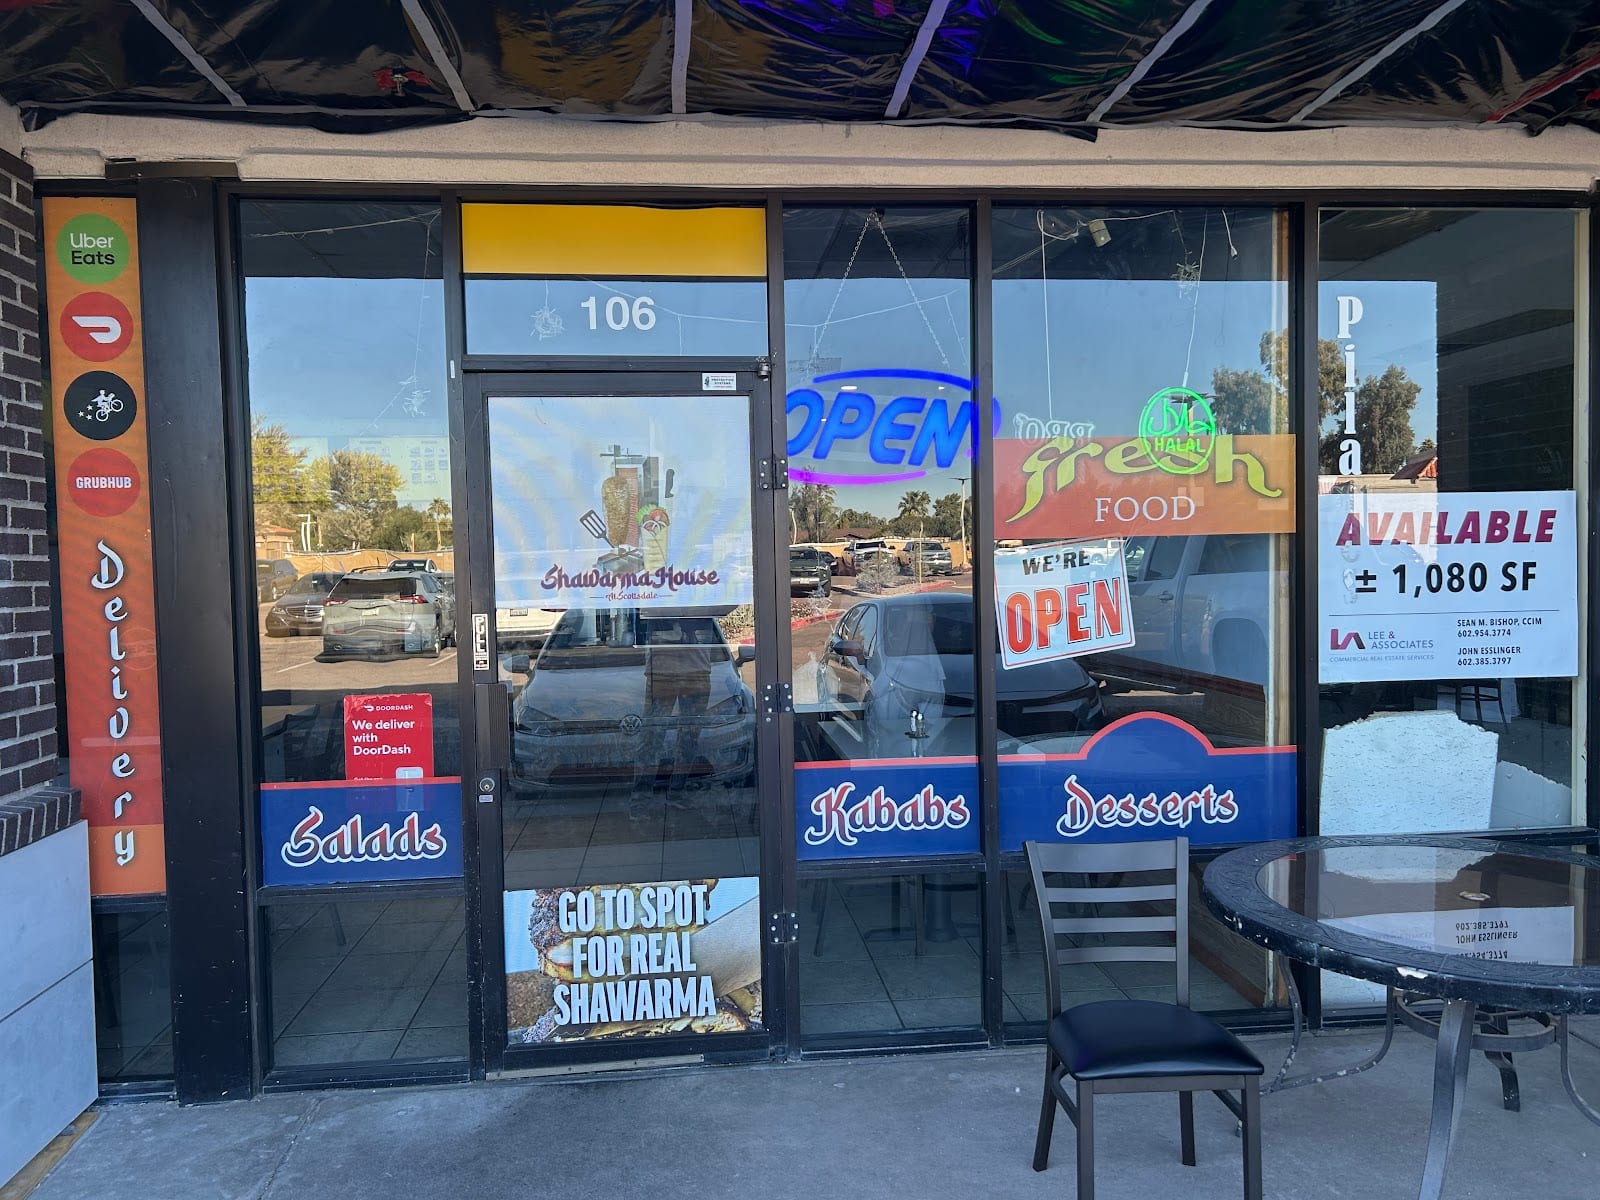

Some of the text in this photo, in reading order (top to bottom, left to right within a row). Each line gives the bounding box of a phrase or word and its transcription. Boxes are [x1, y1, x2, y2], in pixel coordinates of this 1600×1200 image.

[70, 233, 113, 249] Uber
[71, 251, 115, 265] Eats
[580, 296, 656, 331] 106
[786, 388, 971, 468] OPEN
[1154, 437, 1206, 453] HALAL
[76, 476, 132, 489] GRUBHUB
[1005, 433, 1282, 523] fresh
[1095, 495, 1196, 523] FOOD
[1335, 509, 1557, 546] AVAILABLE
[1022, 550, 1091, 576] WE'RE
[540, 563, 720, 592] Shawarma House
[1392, 561, 1488, 598] 1,080
[1500, 561, 1537, 592] SF
[618, 591, 658, 601] Scottsdale
[1005, 577, 1123, 654] OPEN
[1457, 617, 1542, 627] SEAN M. BISHOP, CCIM
[475, 616, 486, 653] PULL
[1368, 631, 1385, 640] LEE
[1388, 630, 1395, 639] &
[1371, 640, 1434, 649] ASSOCIATES
[1457, 628, 1511, 638] 602.954.3774
[1457, 657, 1511, 666] 602.385.3797
[1458, 646, 1521, 656] JOHN ESSLINGER
[91, 539, 136, 867] Delivery
[352, 719, 415, 730] We deliver
[352, 733, 378, 743] with
[353, 744, 411, 756] DoorDash
[804, 781, 970, 846] Kababs
[1056, 774, 1239, 837] Desserts
[281, 805, 447, 867] Salads
[558, 885, 708, 933] GO TO SPOT
[573, 931, 697, 978] FOR REAL
[553, 975, 717, 1026] SHAWARMA
